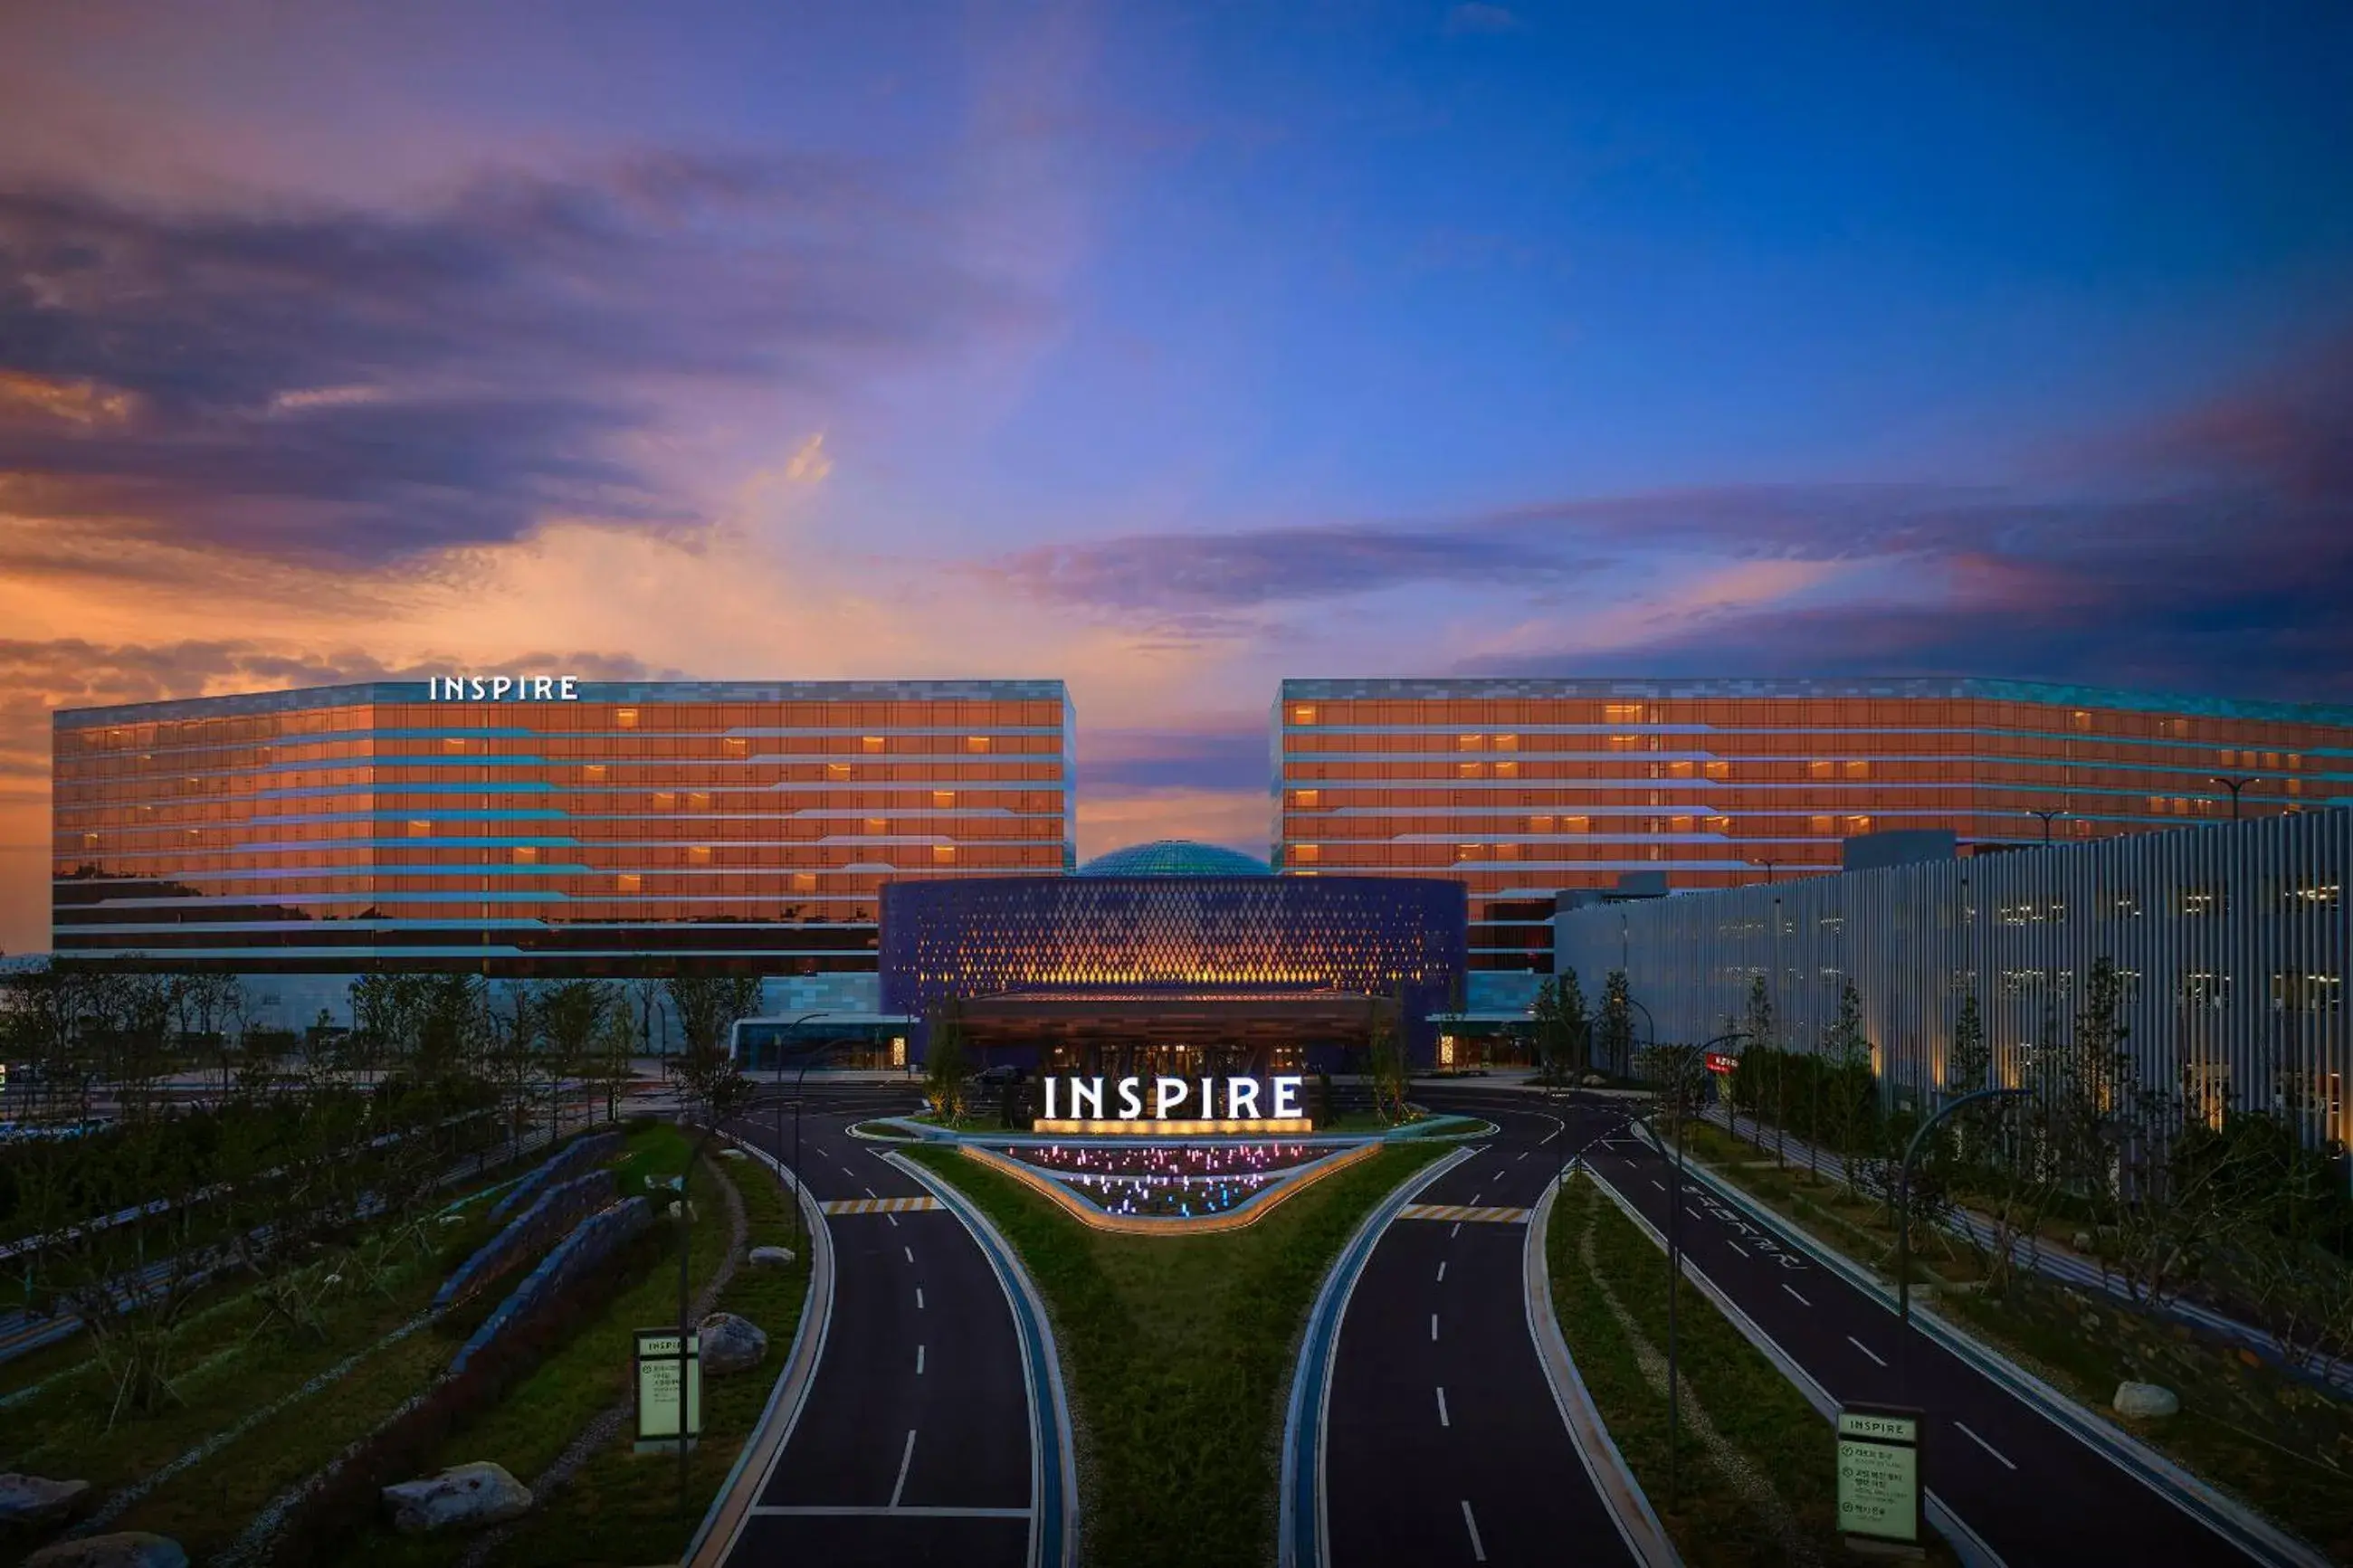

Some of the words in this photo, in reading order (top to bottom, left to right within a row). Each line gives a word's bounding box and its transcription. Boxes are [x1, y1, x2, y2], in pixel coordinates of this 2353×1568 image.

[430, 676, 578, 700] INSPIRE
[1043, 1076, 1303, 1119] INSPIRE
[648, 1342, 681, 1351] INSPI
[1850, 1420, 1904, 1434] INSPIRE
